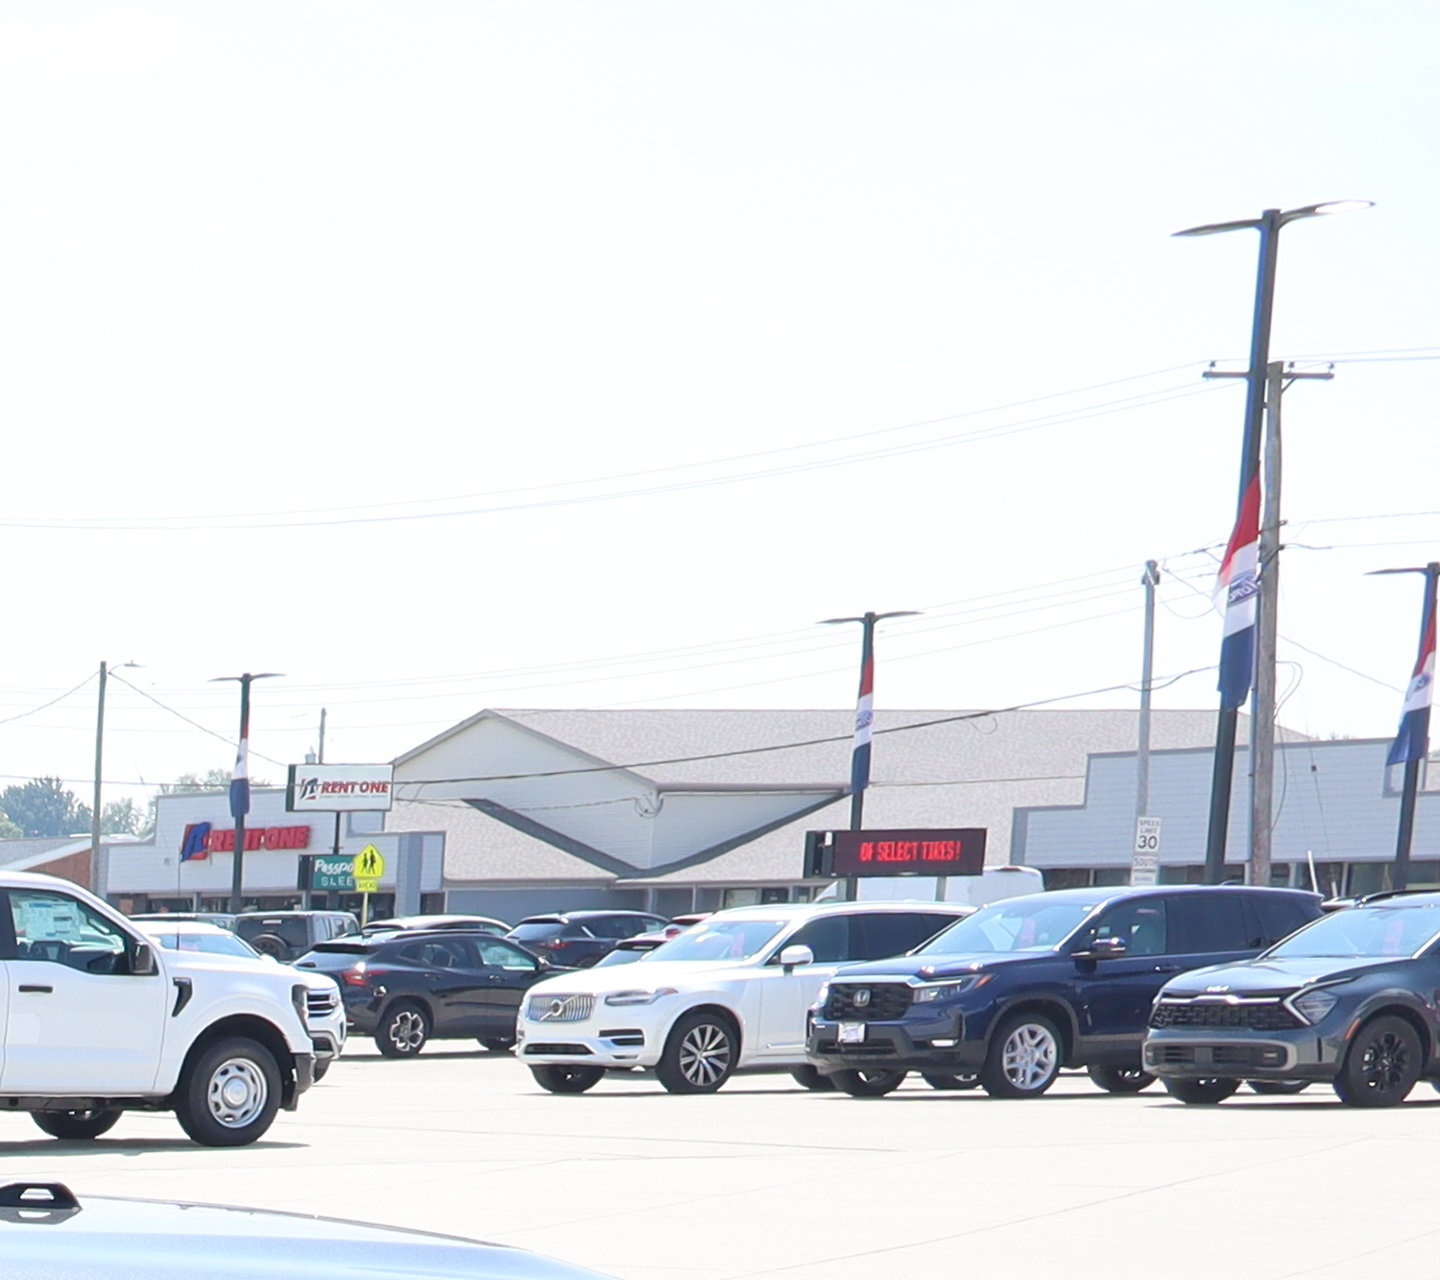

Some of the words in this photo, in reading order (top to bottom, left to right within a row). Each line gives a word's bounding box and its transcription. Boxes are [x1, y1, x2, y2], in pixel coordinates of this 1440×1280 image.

[321, 781, 358, 794] RENT
[359, 780, 389, 793] ONE
[265, 825, 310, 851] ONE
[1137, 835, 1158, 849] 30
[859, 842, 875, 861] OF
[876, 841, 918, 861] SELECT
